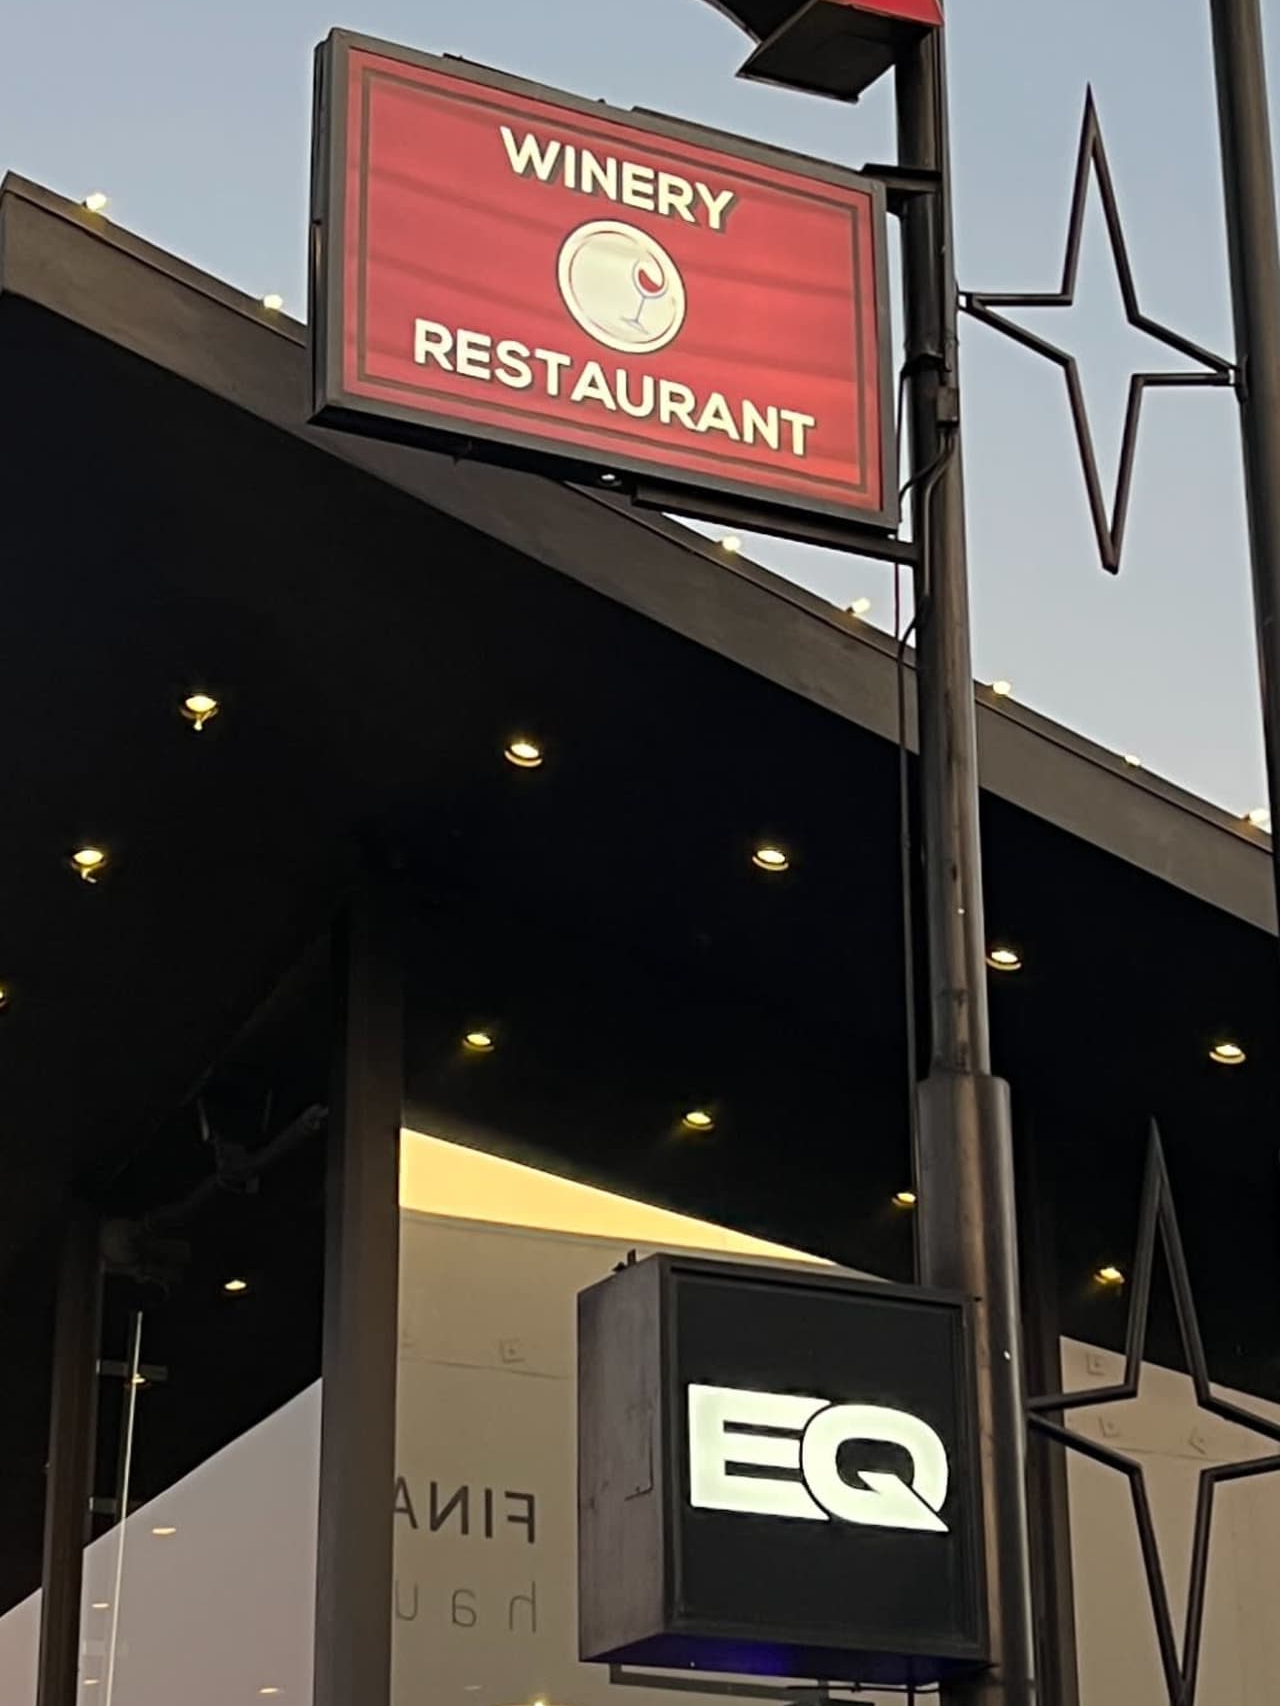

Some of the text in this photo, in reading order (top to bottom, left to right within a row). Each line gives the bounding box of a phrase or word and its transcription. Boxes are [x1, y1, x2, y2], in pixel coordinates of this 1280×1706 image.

[500, 126, 734, 230] WINERY
[414, 319, 815, 457] RESTAURANT
[688, 1383, 949, 1532] EQ
